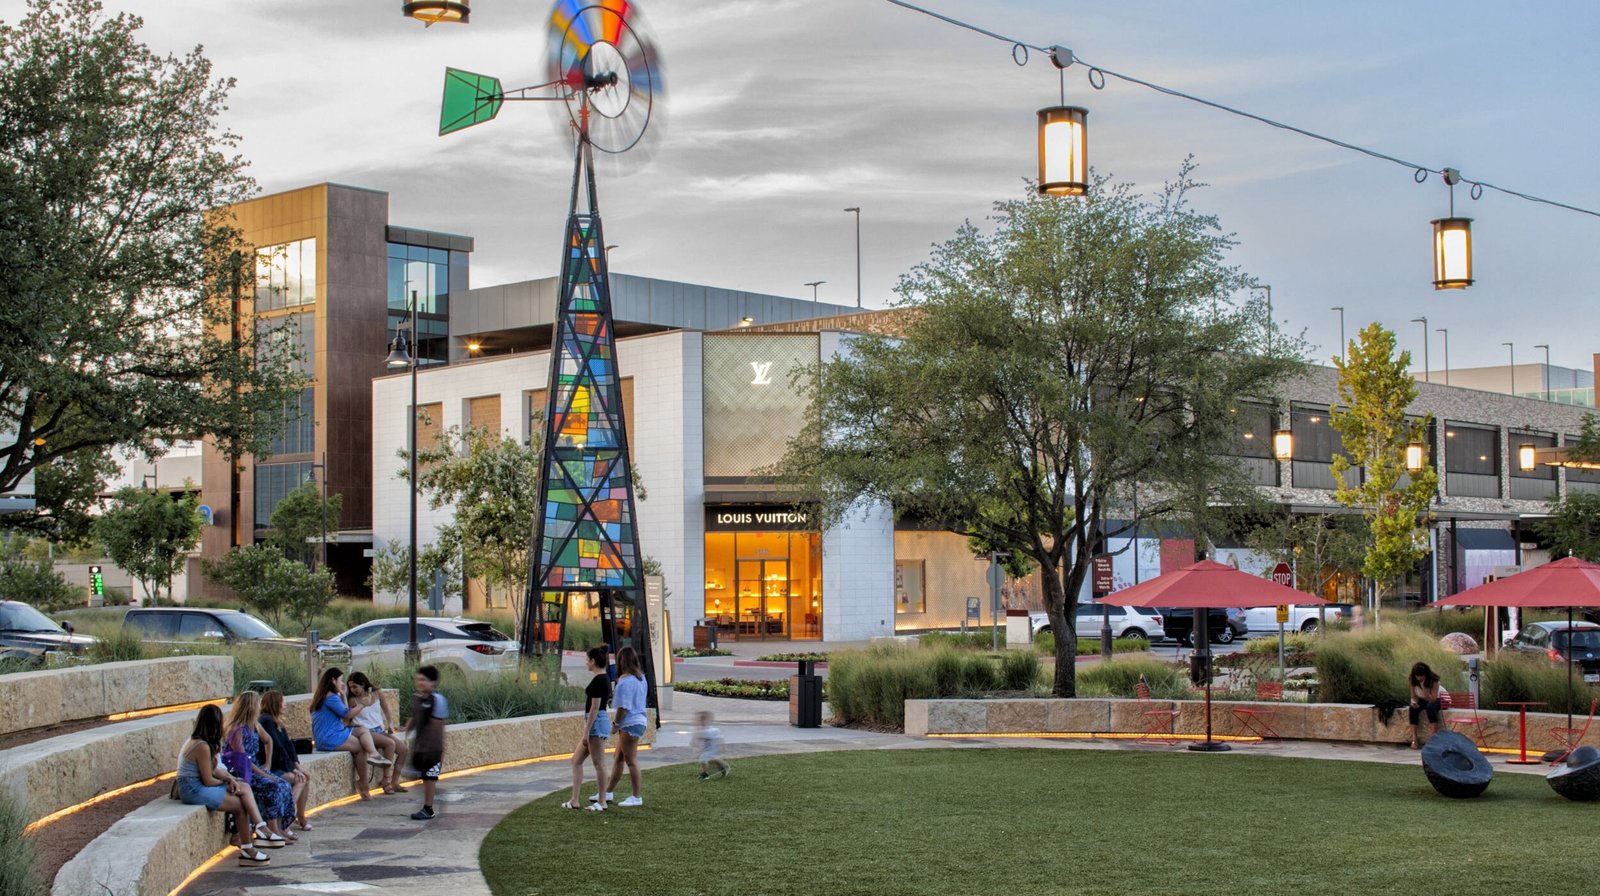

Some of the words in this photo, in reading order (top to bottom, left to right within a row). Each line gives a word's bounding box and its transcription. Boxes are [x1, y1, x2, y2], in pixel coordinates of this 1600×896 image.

[718, 513, 752, 524] LOUIS
[756, 513, 807, 524] VUITTON
[1273, 573, 1291, 585] STOP
